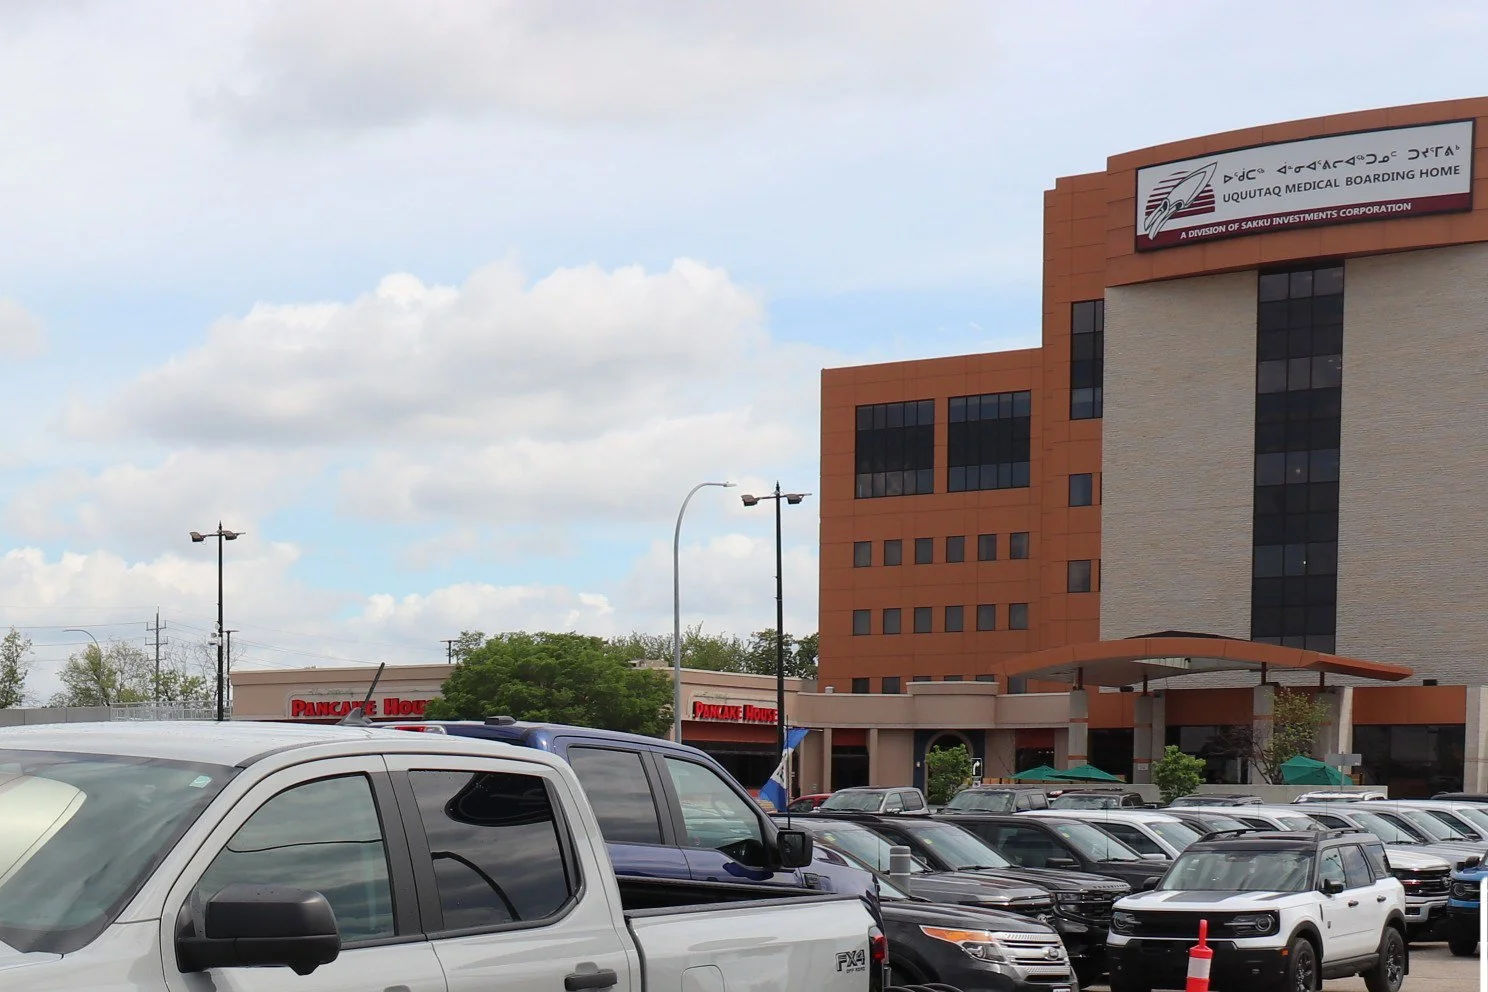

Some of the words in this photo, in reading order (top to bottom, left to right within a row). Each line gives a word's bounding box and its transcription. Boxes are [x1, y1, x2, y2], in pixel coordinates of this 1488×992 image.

[1223, 185, 1282, 203] UQUUTAQ
[1285, 178, 1340, 195] MEDICAL
[1345, 169, 1416, 187] BOARDING
[1419, 165, 1461, 179] HOME
[1180, 231, 1187, 240] A
[1188, 224, 1226, 238] DIVISION
[1227, 222, 1240, 234] OF
[1241, 217, 1271, 230] SAKKU
[1272, 209, 1337, 226] INVESTMENTS
[1339, 202, 1412, 217] CORPORATION
[693, 701, 743, 720] PANCAKE
[743, 704, 778, 722] HOUSE
[835, 949, 866, 972] FX4
